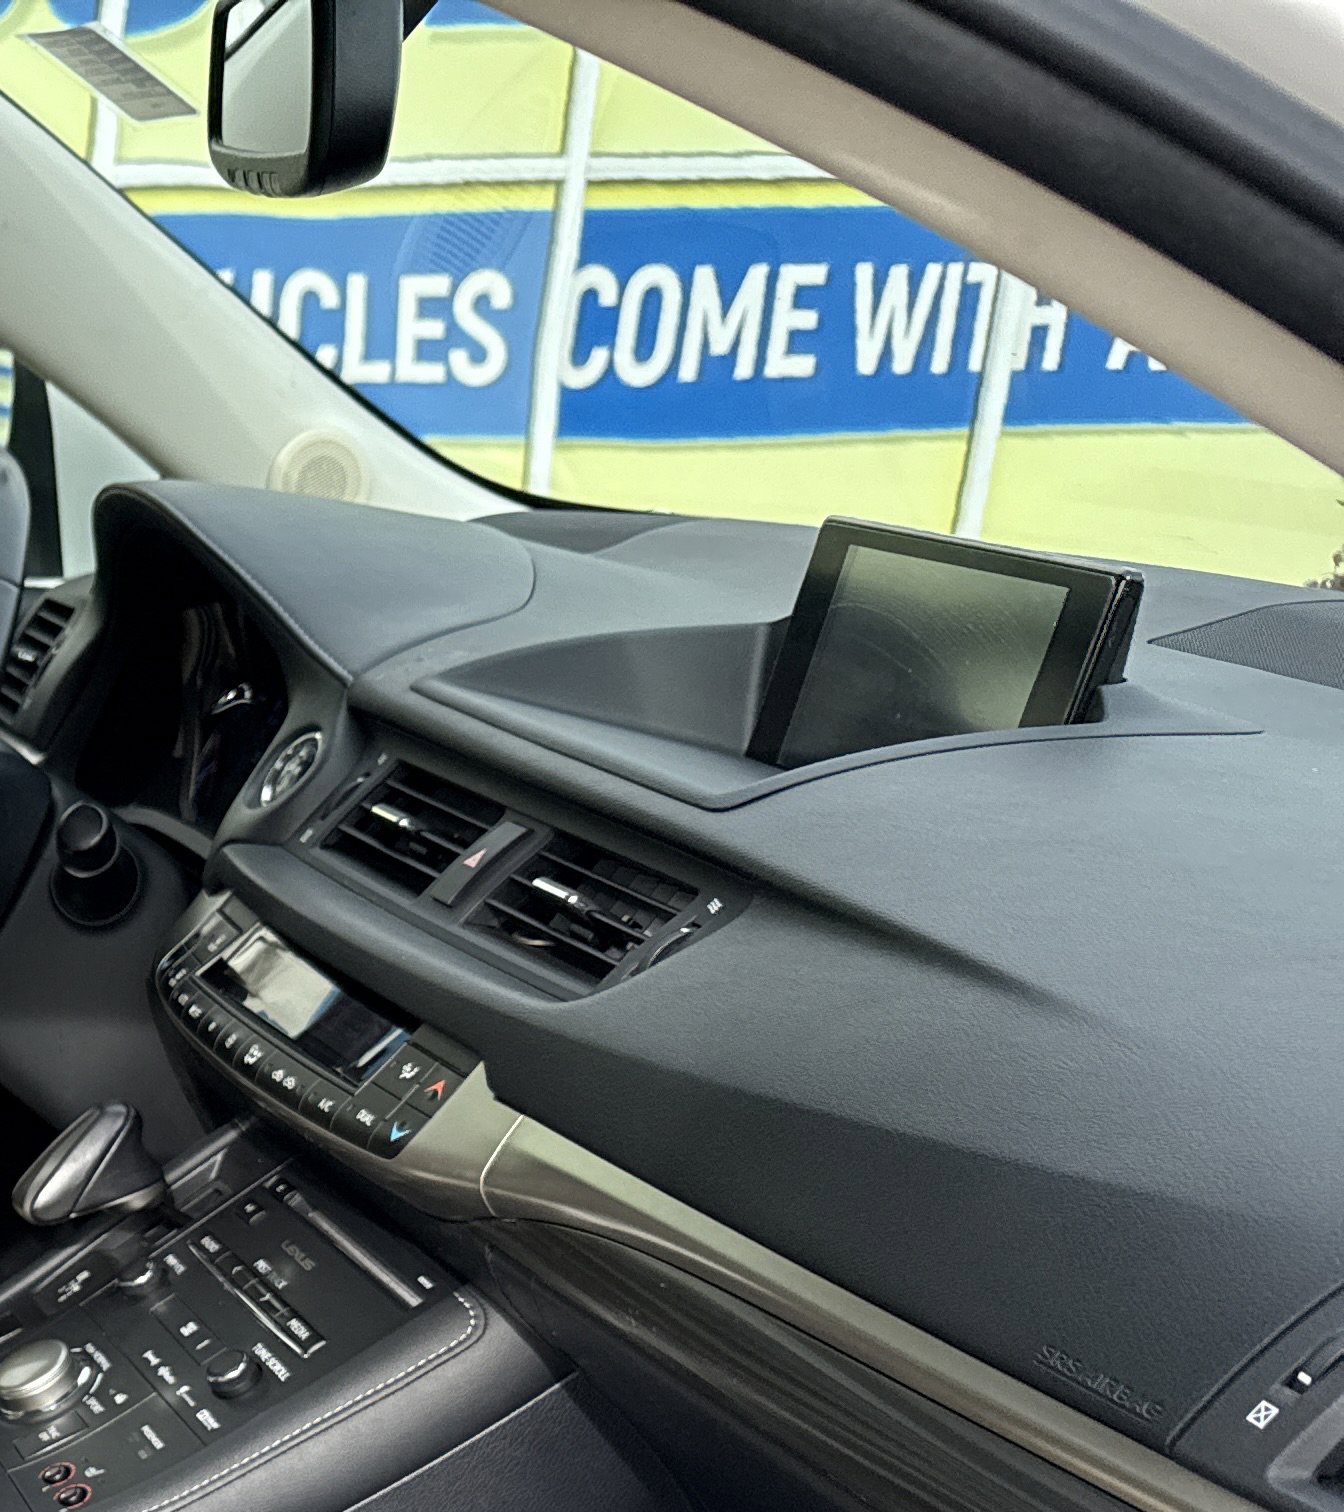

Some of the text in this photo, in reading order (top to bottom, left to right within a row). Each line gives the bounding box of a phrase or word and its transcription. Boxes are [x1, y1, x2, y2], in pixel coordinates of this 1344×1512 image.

[556, 262, 830, 391] COME
[854, 261, 1068, 377] WITH
[280, 1239, 316, 1272] LEXUS
